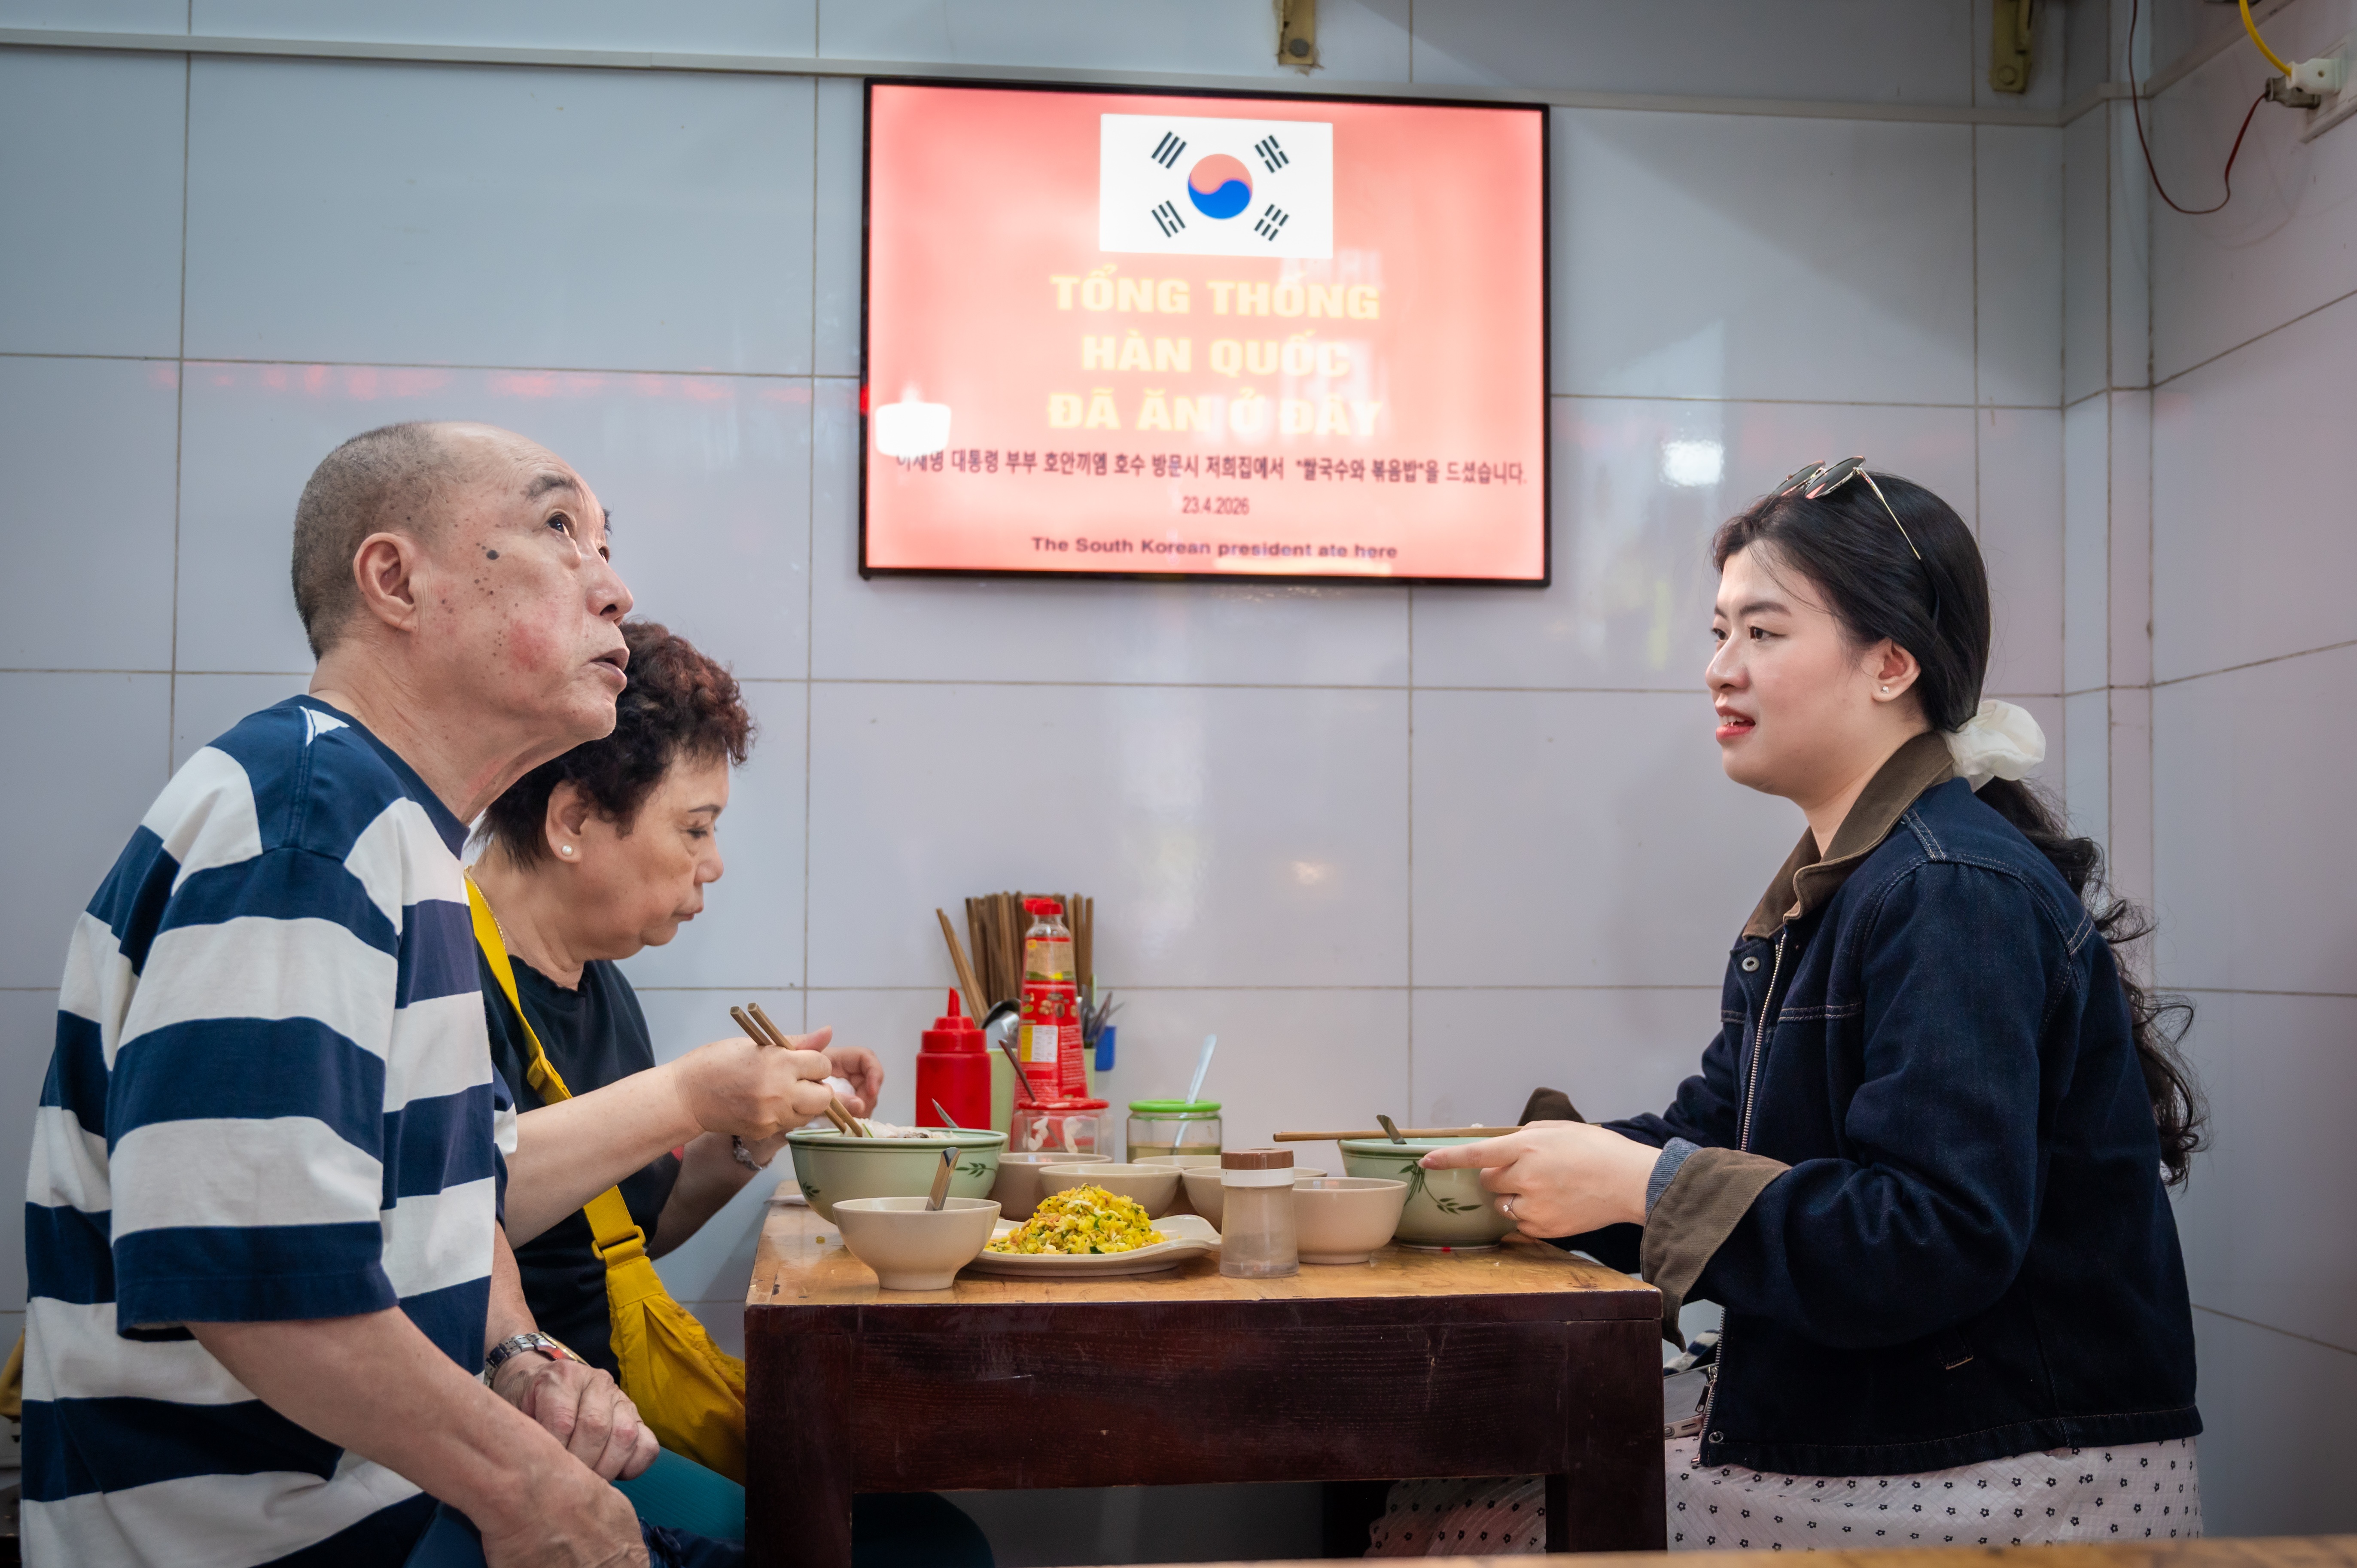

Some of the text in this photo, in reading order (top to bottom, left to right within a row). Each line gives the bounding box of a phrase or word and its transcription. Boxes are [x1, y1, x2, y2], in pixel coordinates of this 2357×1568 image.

[1050, 263, 1381, 320] TỔNG THỐNG
[1081, 328, 1351, 378] HÀN QUỐC
[1047, 386, 1384, 436] ĐÃ ĂN Ở ĐÂY
[951, 449, 999, 473] 대통령
[1005, 451, 1038, 474] 부부
[1044, 451, 1108, 476] 호안끼엠
[1114, 453, 1146, 477] 호수
[1151, 454, 1199, 478] 방문시
[1206, 455, 1284, 480] 저희집에서
[1446, 461, 1527, 485] 드셨습니다.
[1182, 496, 1250, 515] 23.4.2026
[1031, 536, 1398, 559] The South Korean president ate here
